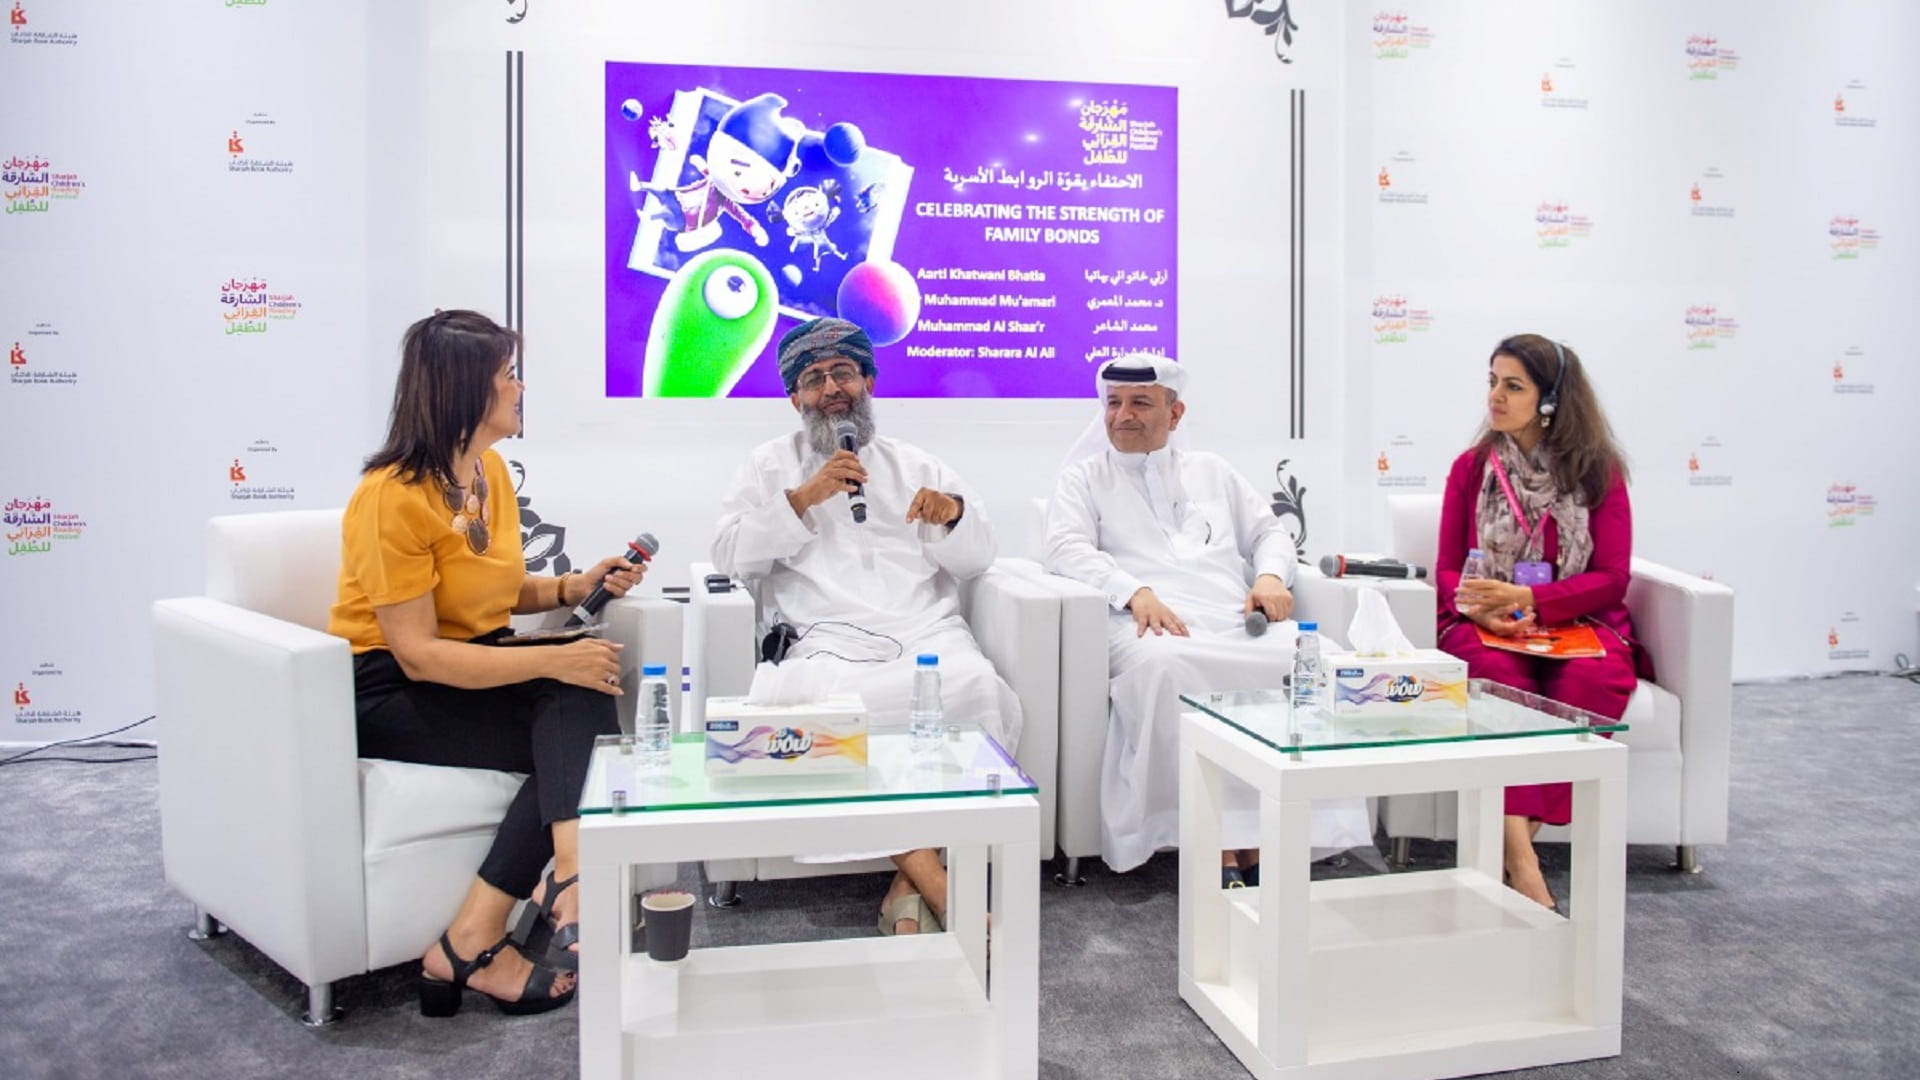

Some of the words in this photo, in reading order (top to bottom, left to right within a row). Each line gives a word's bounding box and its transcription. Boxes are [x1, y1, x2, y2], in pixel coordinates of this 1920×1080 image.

[1090, 173, 1143, 189] الاحتفاء
[916, 202, 1022, 220] CELEBRATING
[1025, 205, 1057, 220] THE
[1060, 206, 1140, 222] STRENGTH
[1143, 209, 1165, 223] OF
[985, 226, 1041, 242] FAMILY
[1045, 228, 1100, 244] BONDS
[917, 268, 947, 280] Aarti
[950, 268, 1006, 281] Khatwani
[1008, 269, 1046, 282] Bhatia
[924, 294, 996, 307] Muhammad
[918, 319, 991, 332] Muhammad
[993, 320, 1006, 332] Al
[906, 345, 975, 358] Moderator:
[977, 346, 1022, 358] Sharara
[1024, 347, 1037, 359] Al
